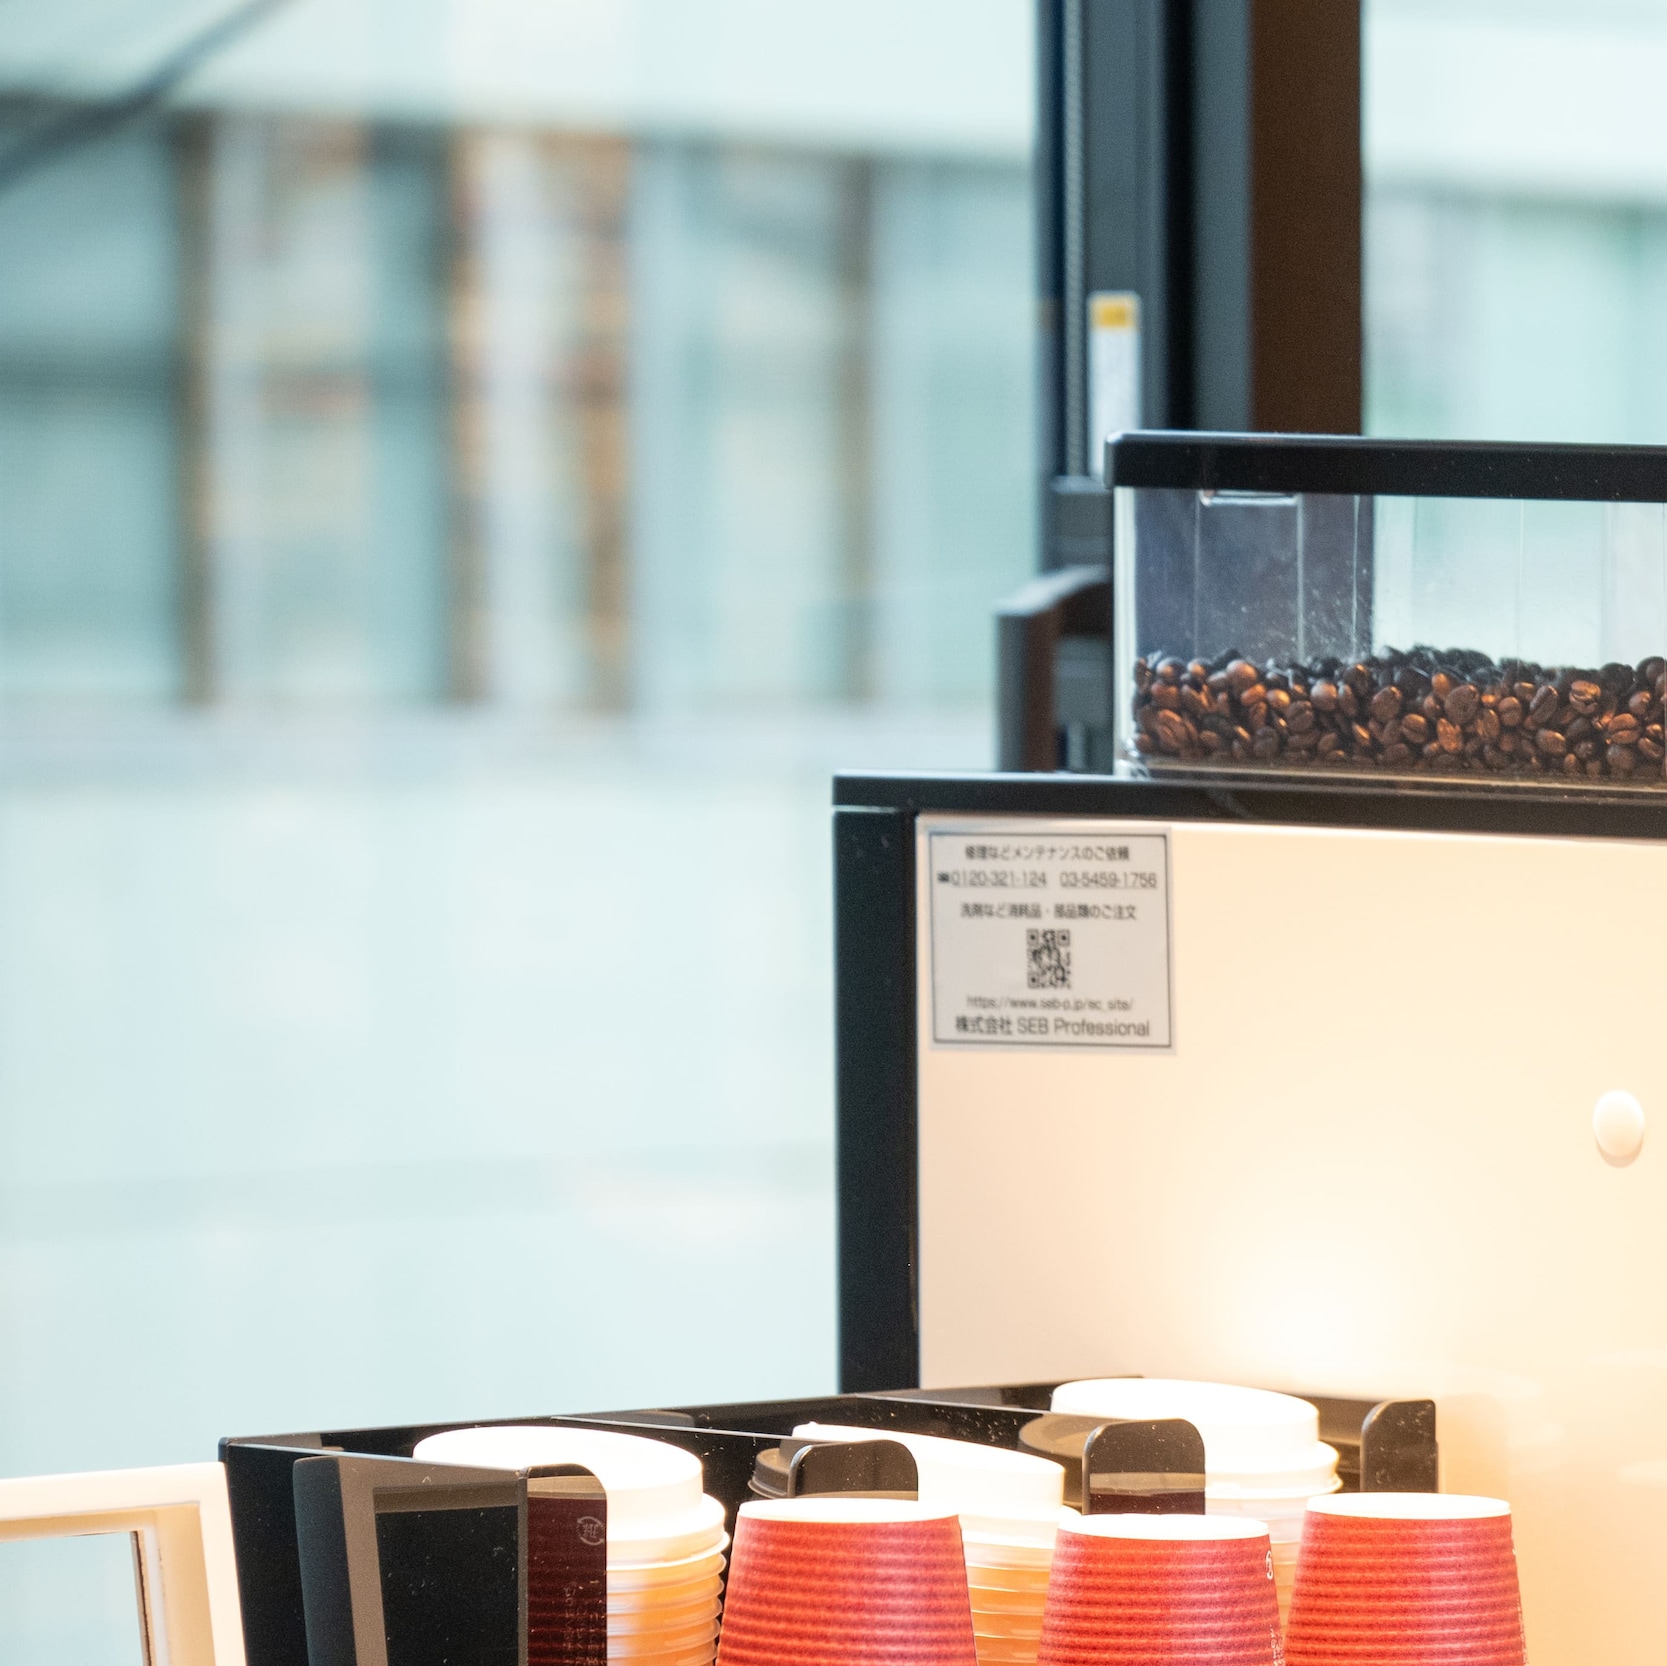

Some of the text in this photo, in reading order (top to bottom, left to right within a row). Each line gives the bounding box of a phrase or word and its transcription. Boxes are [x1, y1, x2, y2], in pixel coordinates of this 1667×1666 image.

[965, 845, 1129, 861] 修理などメンテナンスのご依頼
[951, 871, 1157, 888] 0120-321-124 03-5459-1756
[956, 1016, 1149, 1036] 株式会社 SEB Professional
